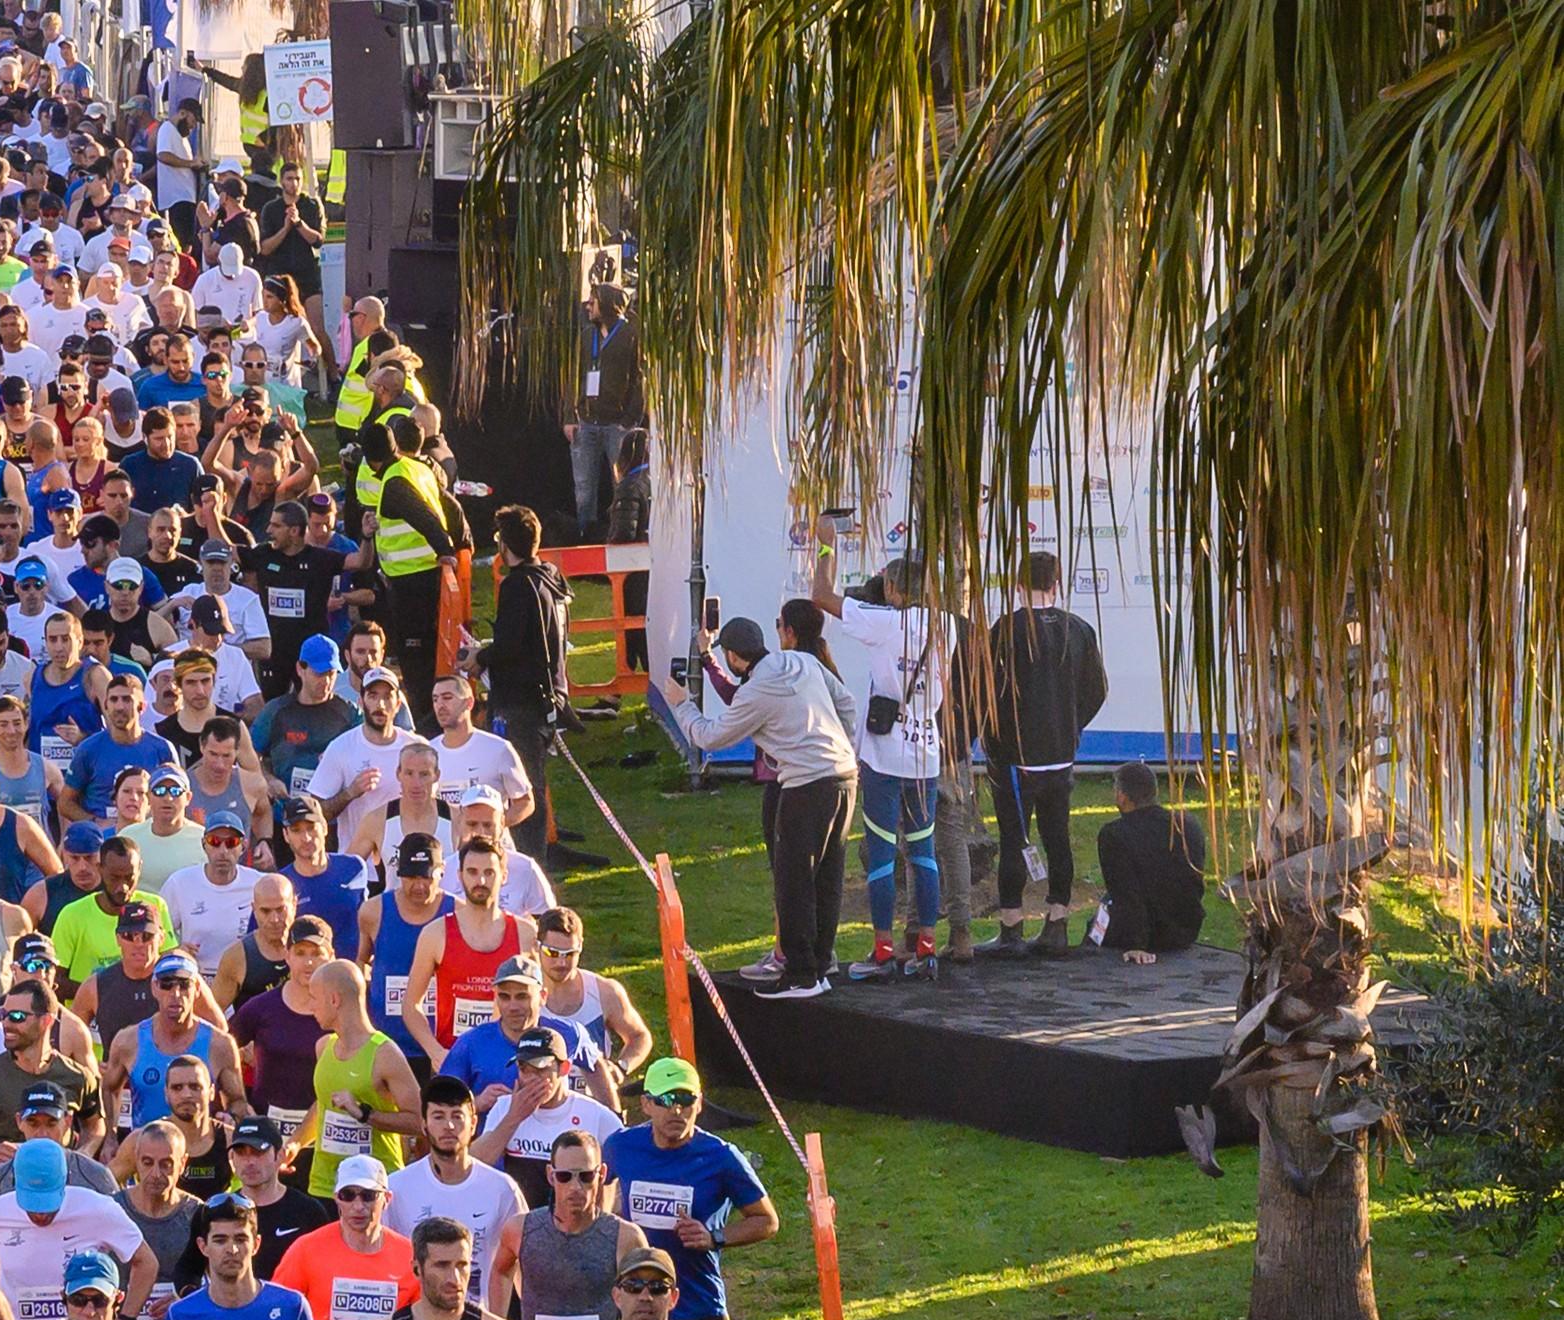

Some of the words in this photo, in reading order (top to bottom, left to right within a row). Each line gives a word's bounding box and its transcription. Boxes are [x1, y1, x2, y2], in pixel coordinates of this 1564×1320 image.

[333, 1127, 358, 1143] 2532
[646, 1199, 675, 1215] 2774
[349, 1296, 380, 1312] 2608
